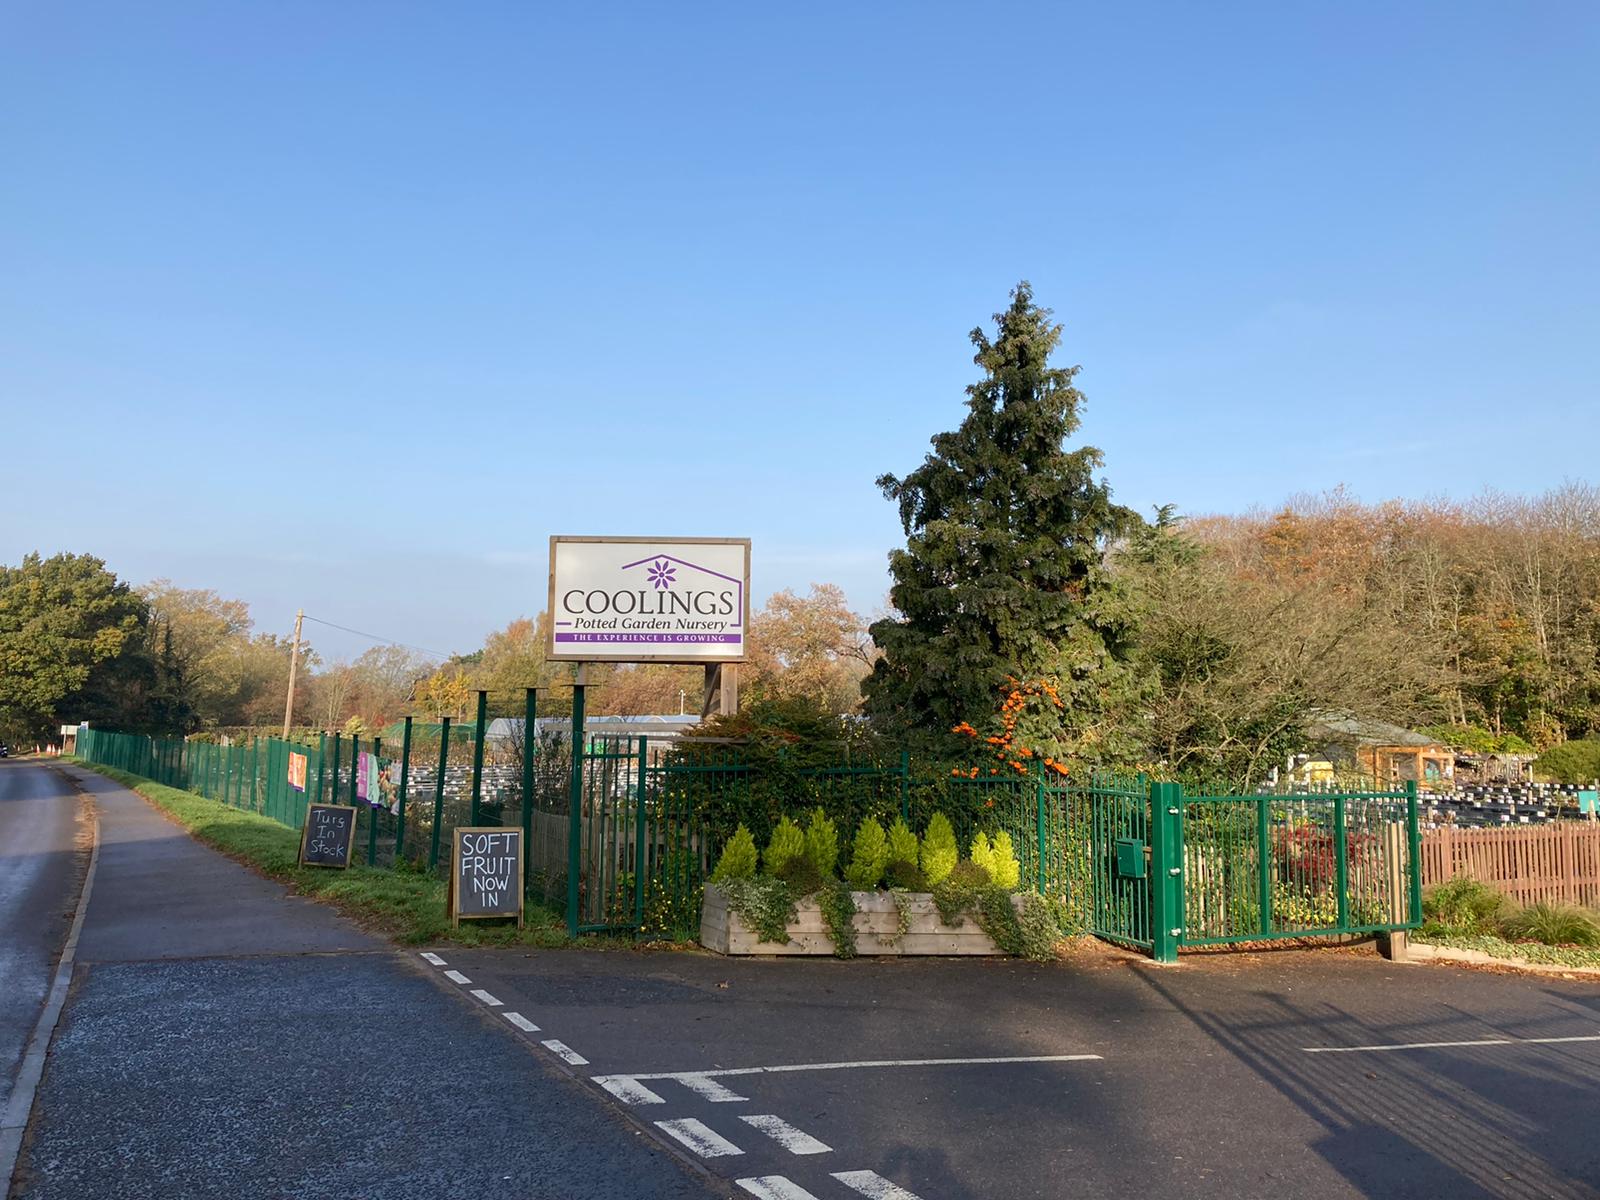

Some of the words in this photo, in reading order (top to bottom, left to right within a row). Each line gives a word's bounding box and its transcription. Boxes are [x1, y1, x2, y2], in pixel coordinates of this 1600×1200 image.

[563, 590, 733, 615] COOLINGS
[574, 617, 617, 629] Potted
[621, 617, 671, 629] Garden
[676, 618, 727, 633] Nursery
[597, 634, 658, 642] EXPERIENCE
[663, 634, 672, 642] IS
[676, 634, 725, 642] GROWING
[316, 825, 335, 839] In
[311, 840, 345, 857] Stock
[462, 833, 518, 855] SOFT
[462, 856, 516, 876] FRUIT
[473, 875, 509, 893] NOW
[482, 891, 498, 907] IN
